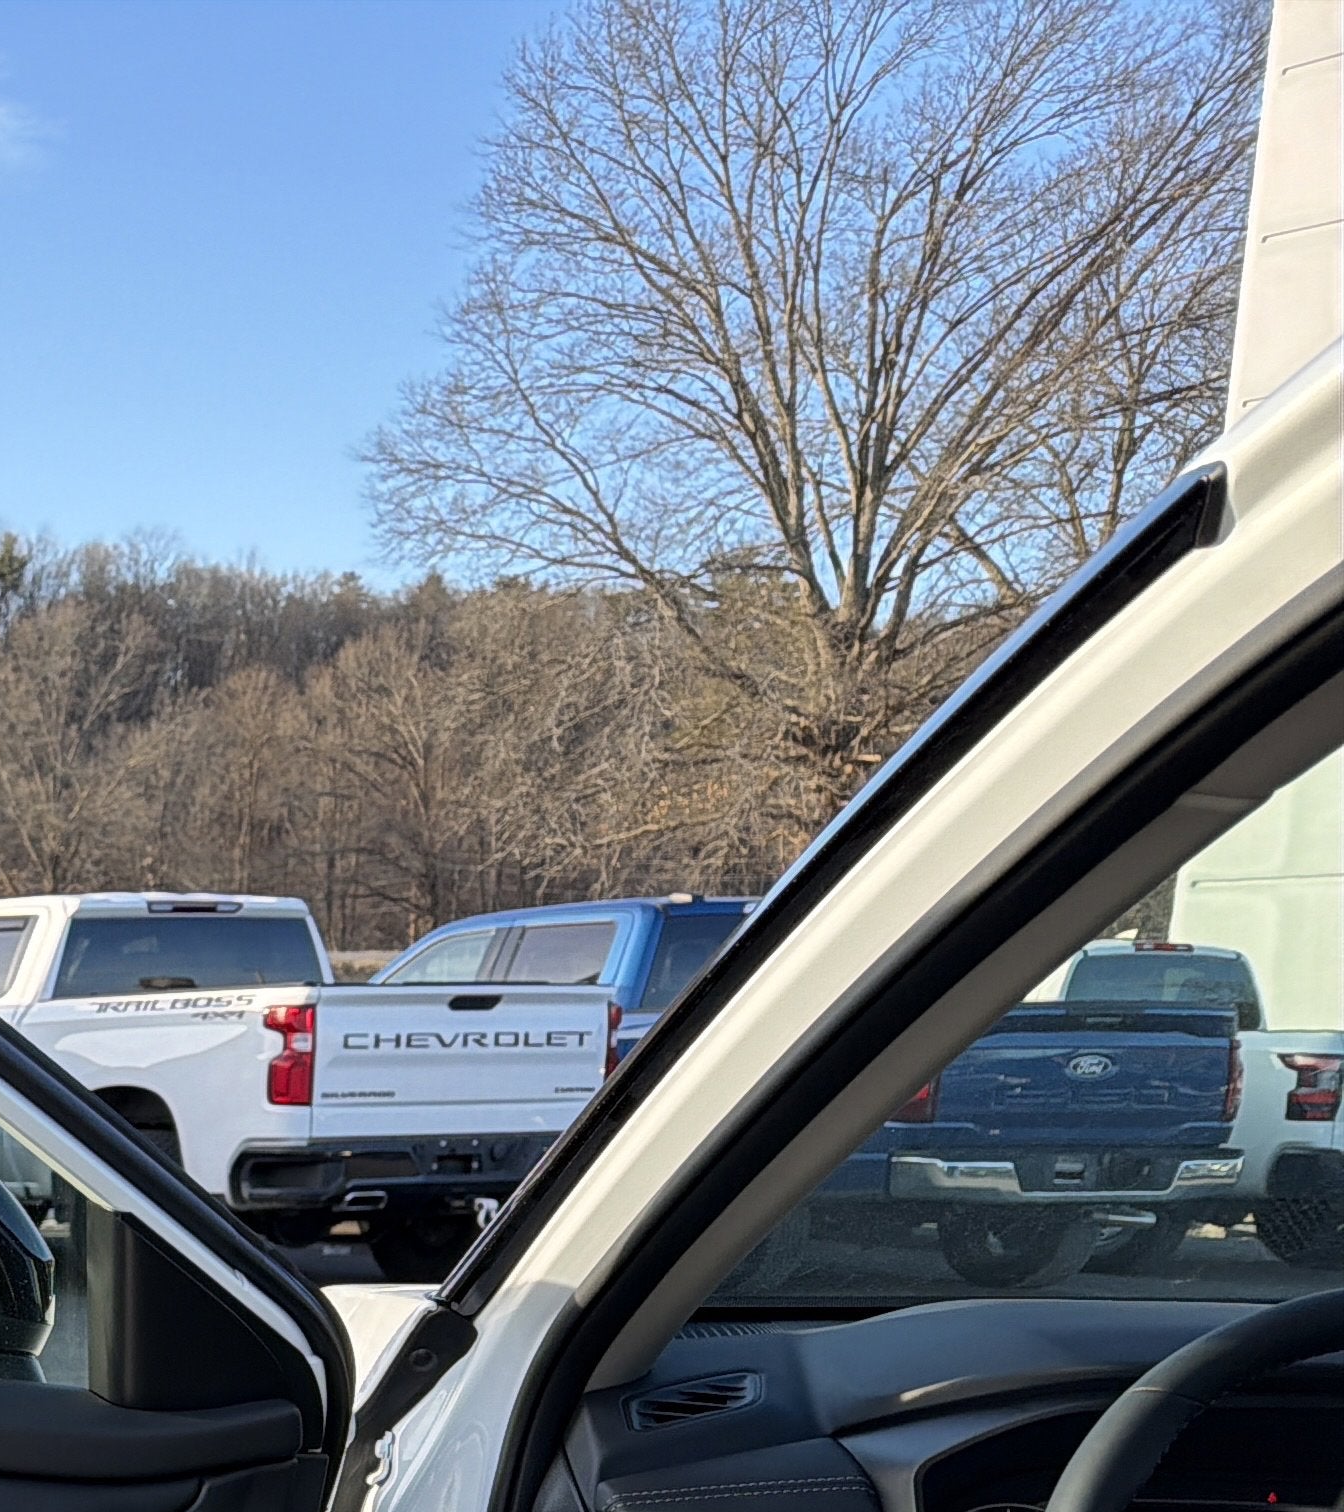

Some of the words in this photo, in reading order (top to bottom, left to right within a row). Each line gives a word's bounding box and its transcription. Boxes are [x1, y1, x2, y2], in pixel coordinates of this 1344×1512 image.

[169, 994, 256, 1010] BOSS
[342, 1030, 593, 1050] CHEVROLET
[1072, 1056, 1109, 1076] Ford
